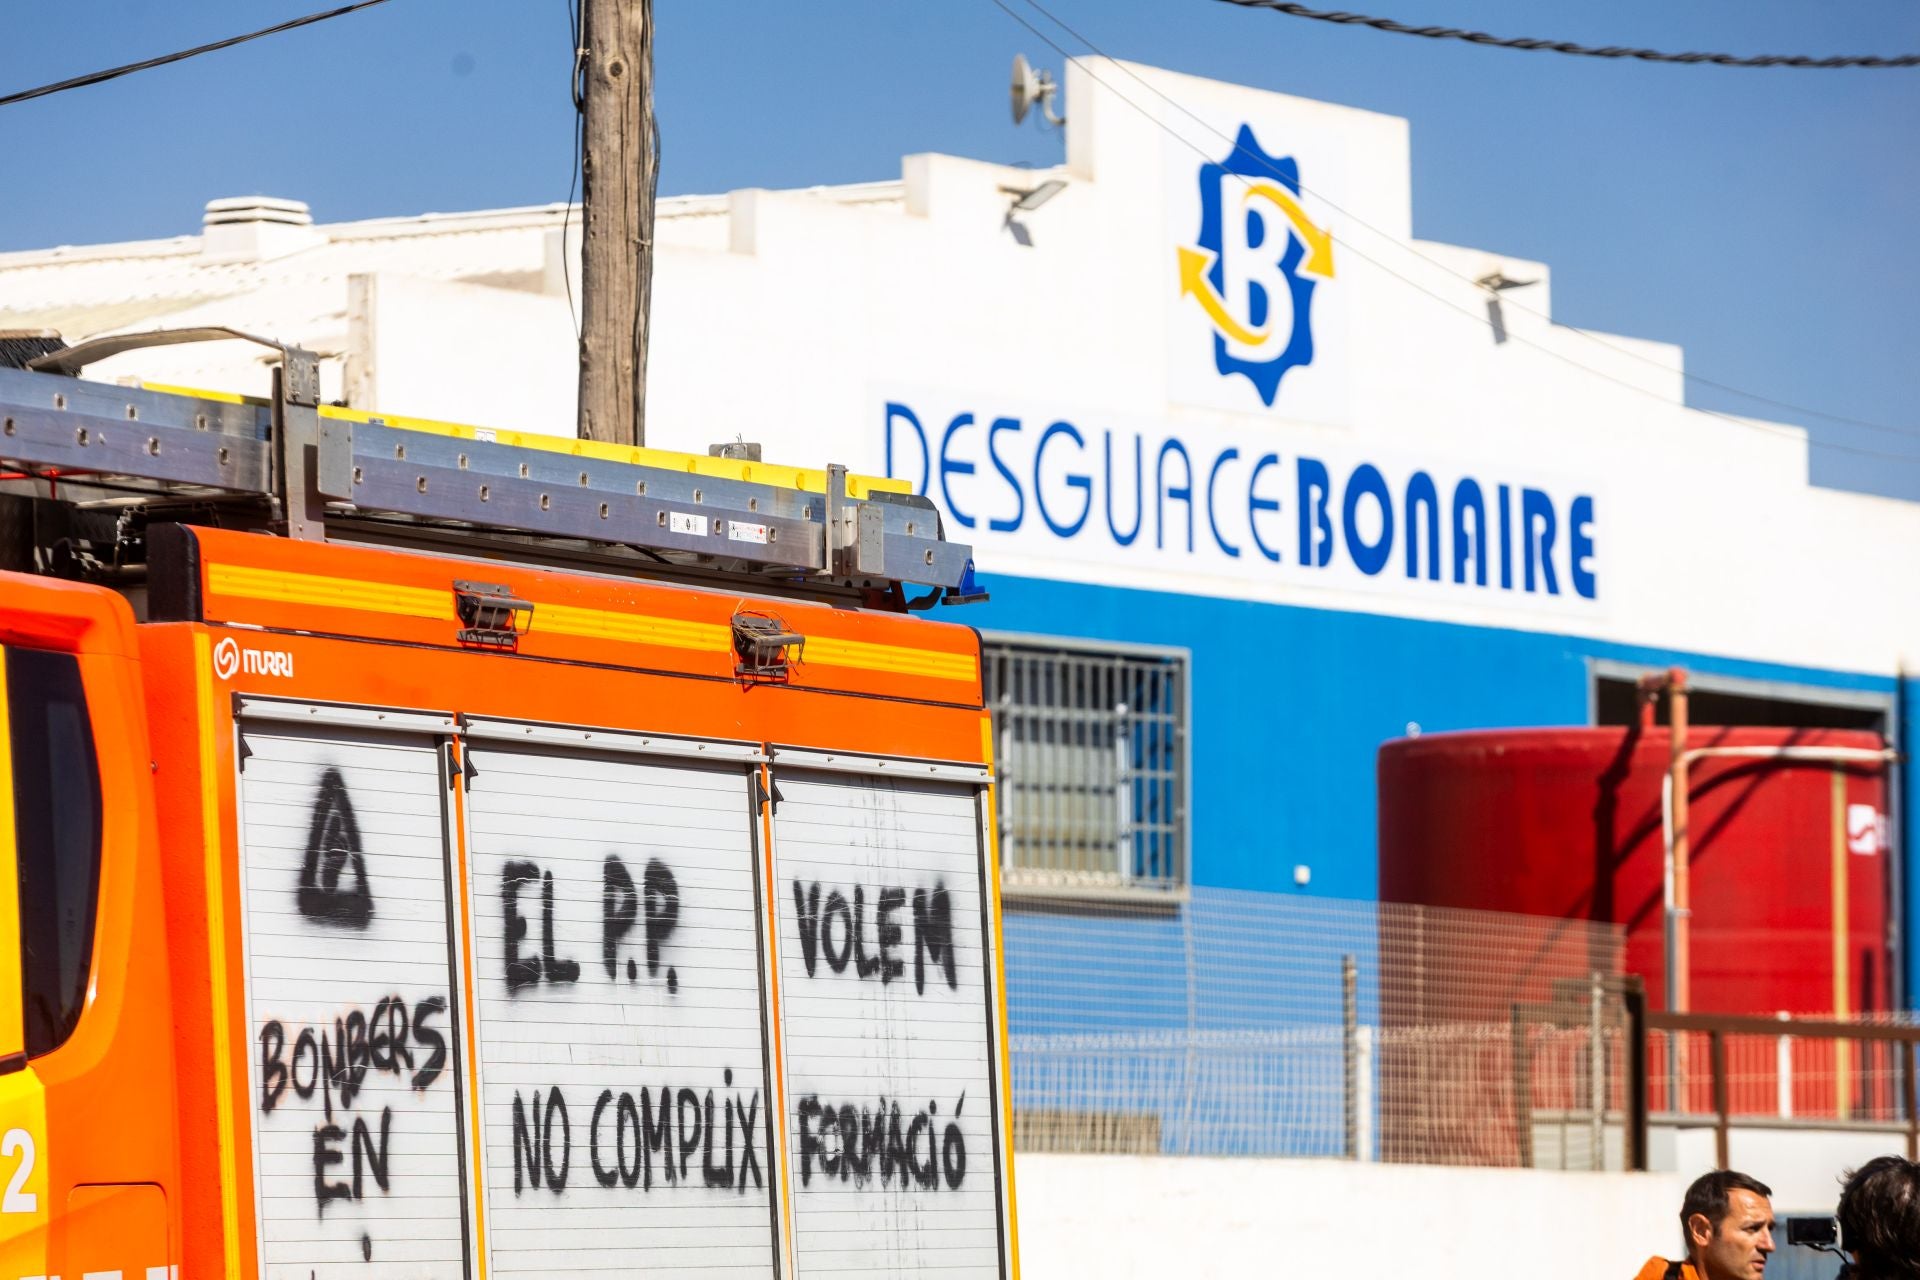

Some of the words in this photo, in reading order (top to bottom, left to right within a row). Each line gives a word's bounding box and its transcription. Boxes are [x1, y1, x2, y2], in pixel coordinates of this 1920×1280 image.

[885, 402, 1281, 563] DESGUACE
[1298, 457, 1597, 600] BONAIRE
[243, 648, 293, 678] ITURRI
[502, 859, 581, 996] EL
[794, 872, 960, 997] VOLEM
[259, 995, 447, 1121] BOMBERS
[1, 1127, 37, 1213] 2
[313, 1104, 392, 1223] EN
[513, 1085, 571, 1197] NO
